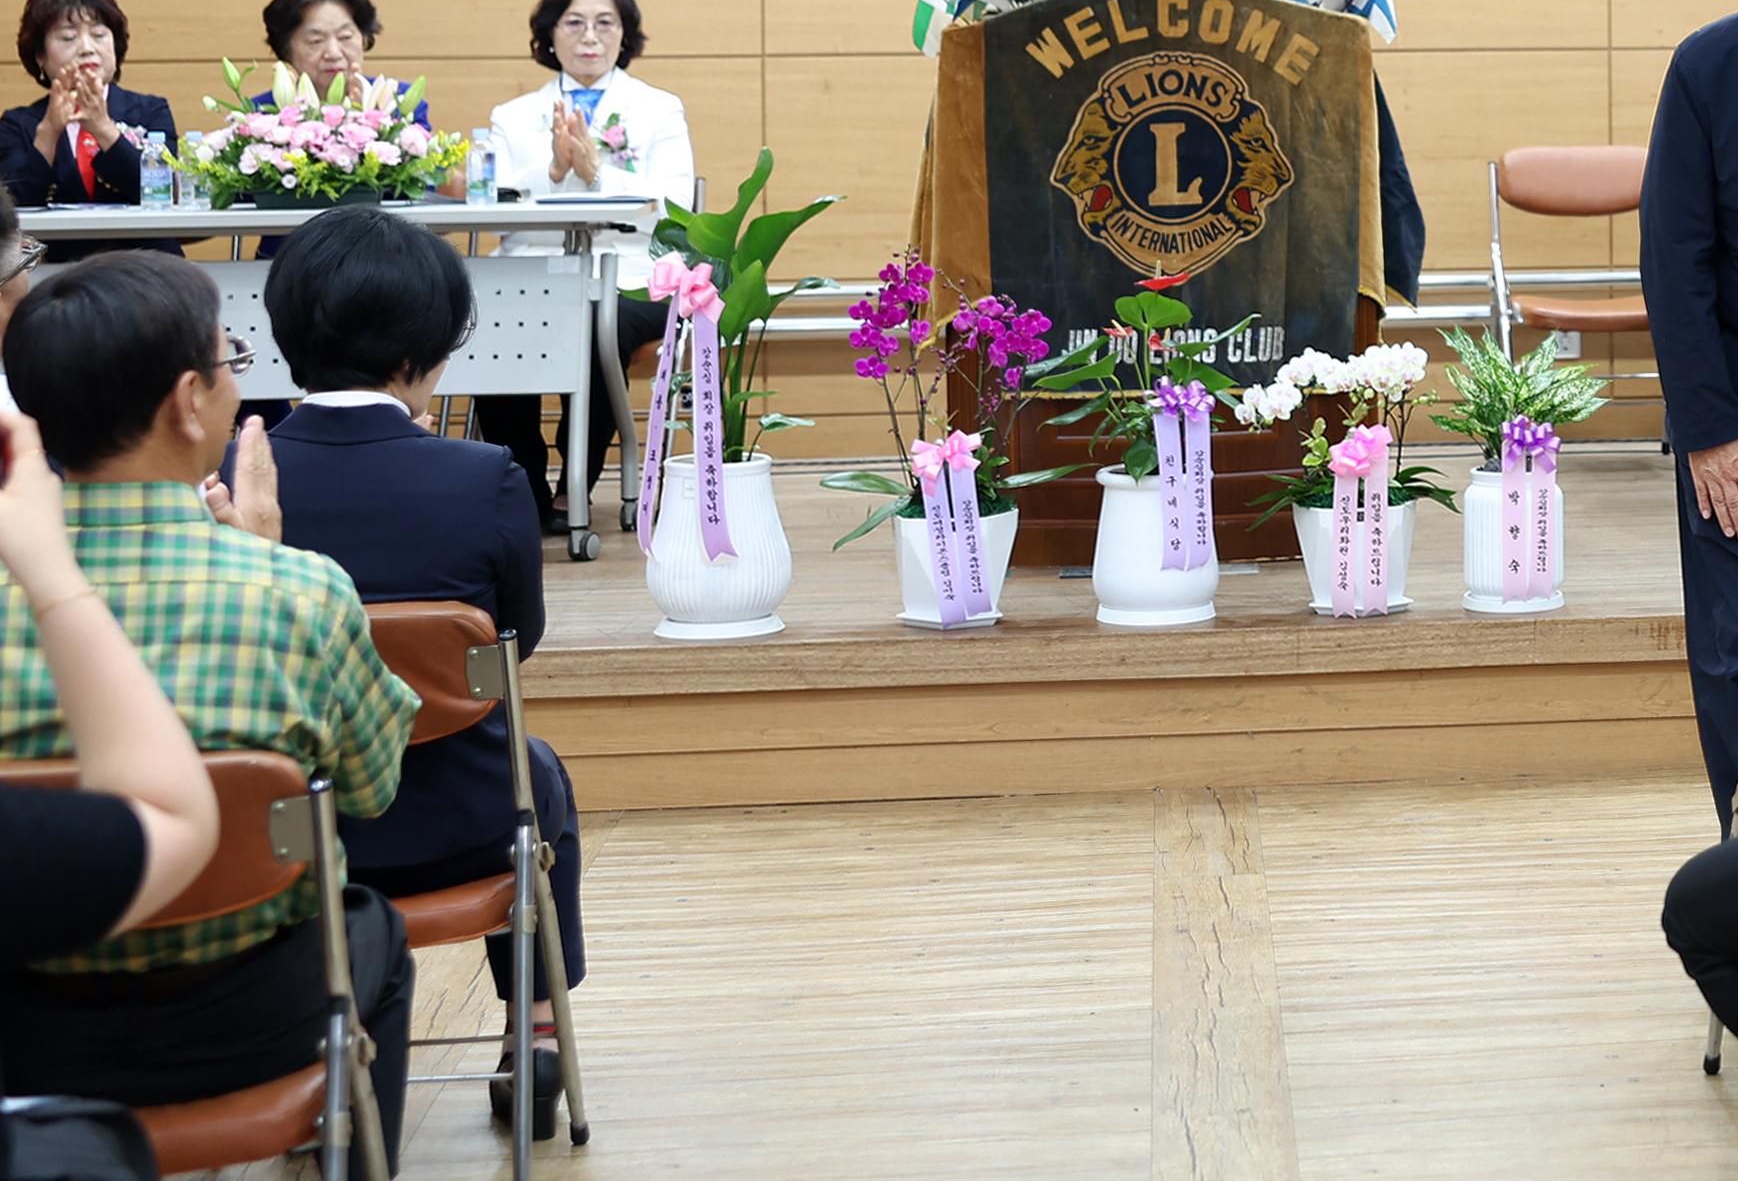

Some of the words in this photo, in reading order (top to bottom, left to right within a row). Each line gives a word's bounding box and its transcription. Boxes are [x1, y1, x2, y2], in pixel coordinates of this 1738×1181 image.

[1117, 68, 1230, 109] LIONS
[1147, 122, 1204, 207] L
[1111, 212, 1230, 255] INTERNATIONAL
[1227, 325, 1287, 364] CLUB
[702, 389, 716, 416] 회장
[702, 421, 717, 460] 취임을
[704, 463, 722, 526] 축하합니다
[1370, 492, 1383, 523] 취임을
[1370, 526, 1384, 588] 축하드립니다
